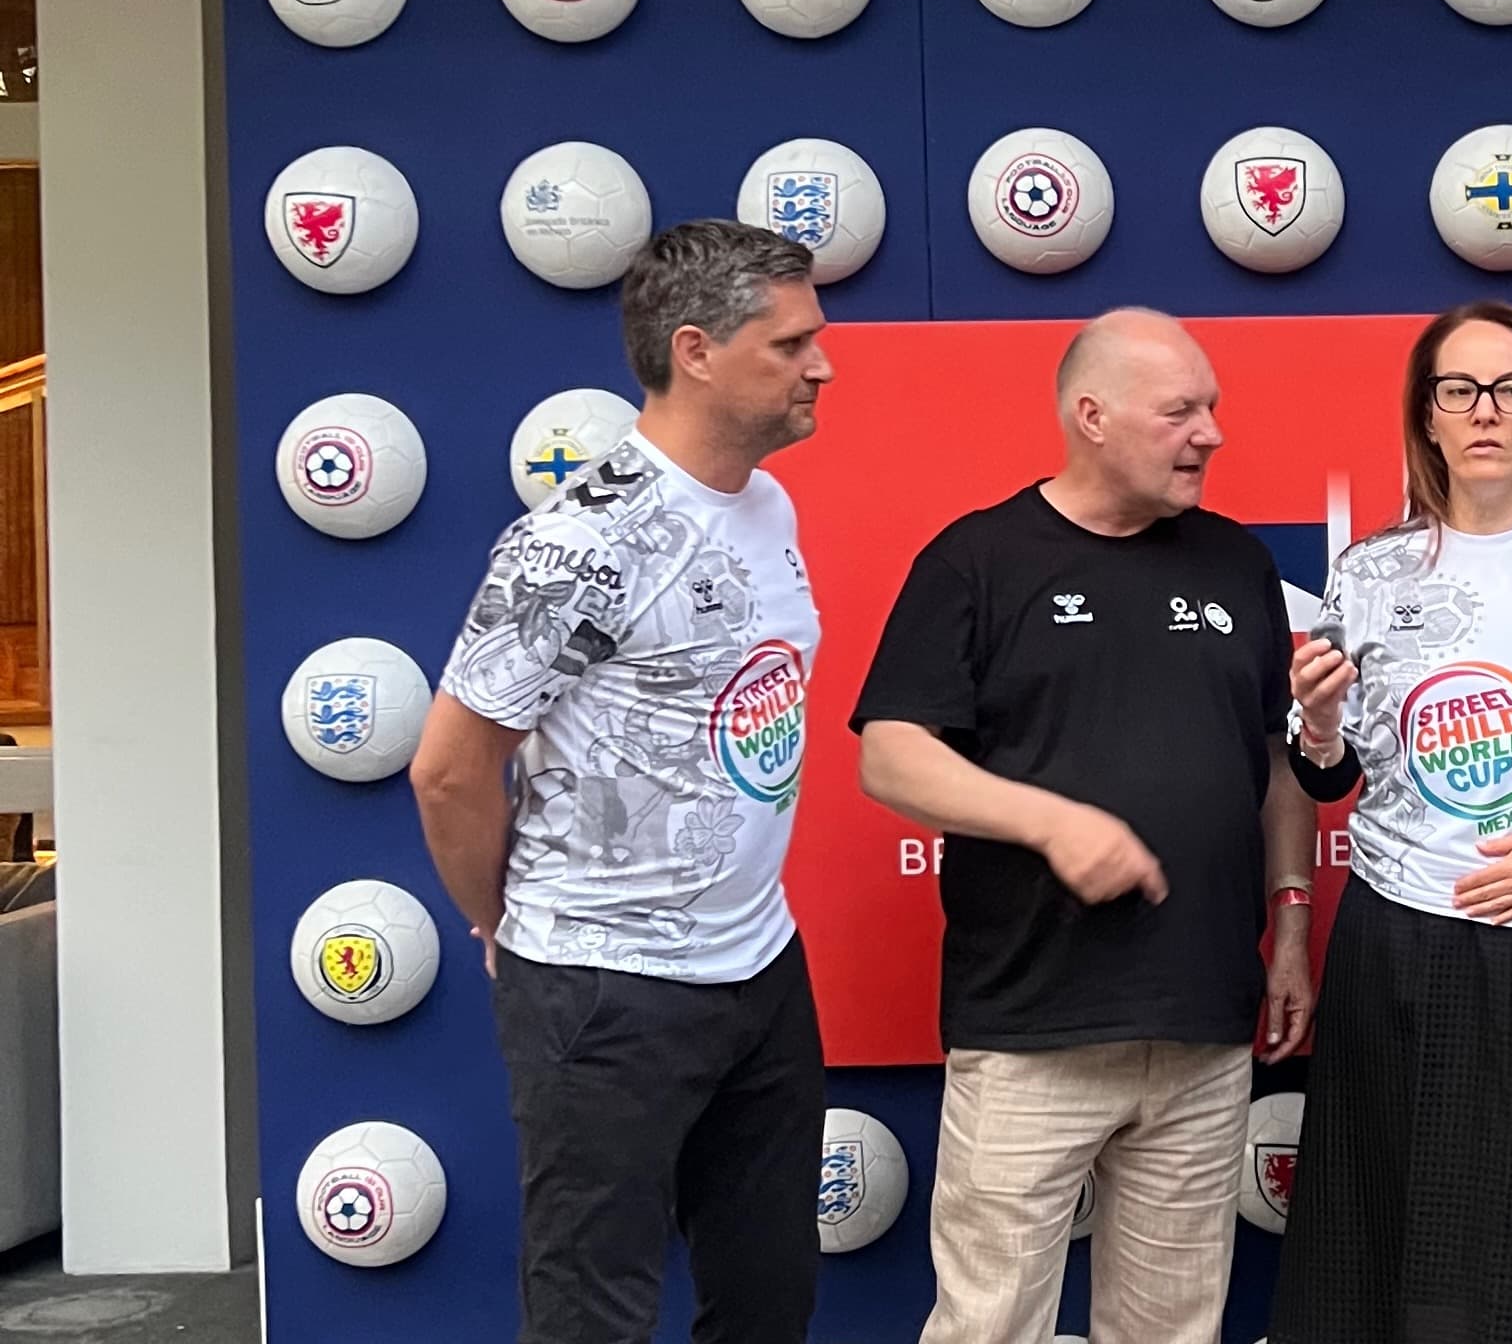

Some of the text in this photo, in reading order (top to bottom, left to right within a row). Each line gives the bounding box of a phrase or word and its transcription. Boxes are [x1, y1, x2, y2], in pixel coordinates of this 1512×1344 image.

[1005, 159, 1062, 184] FOOTBALL
[731, 679, 799, 738] CHILD
[733, 663, 792, 712] STREET
[758, 728, 800, 775] CUP
